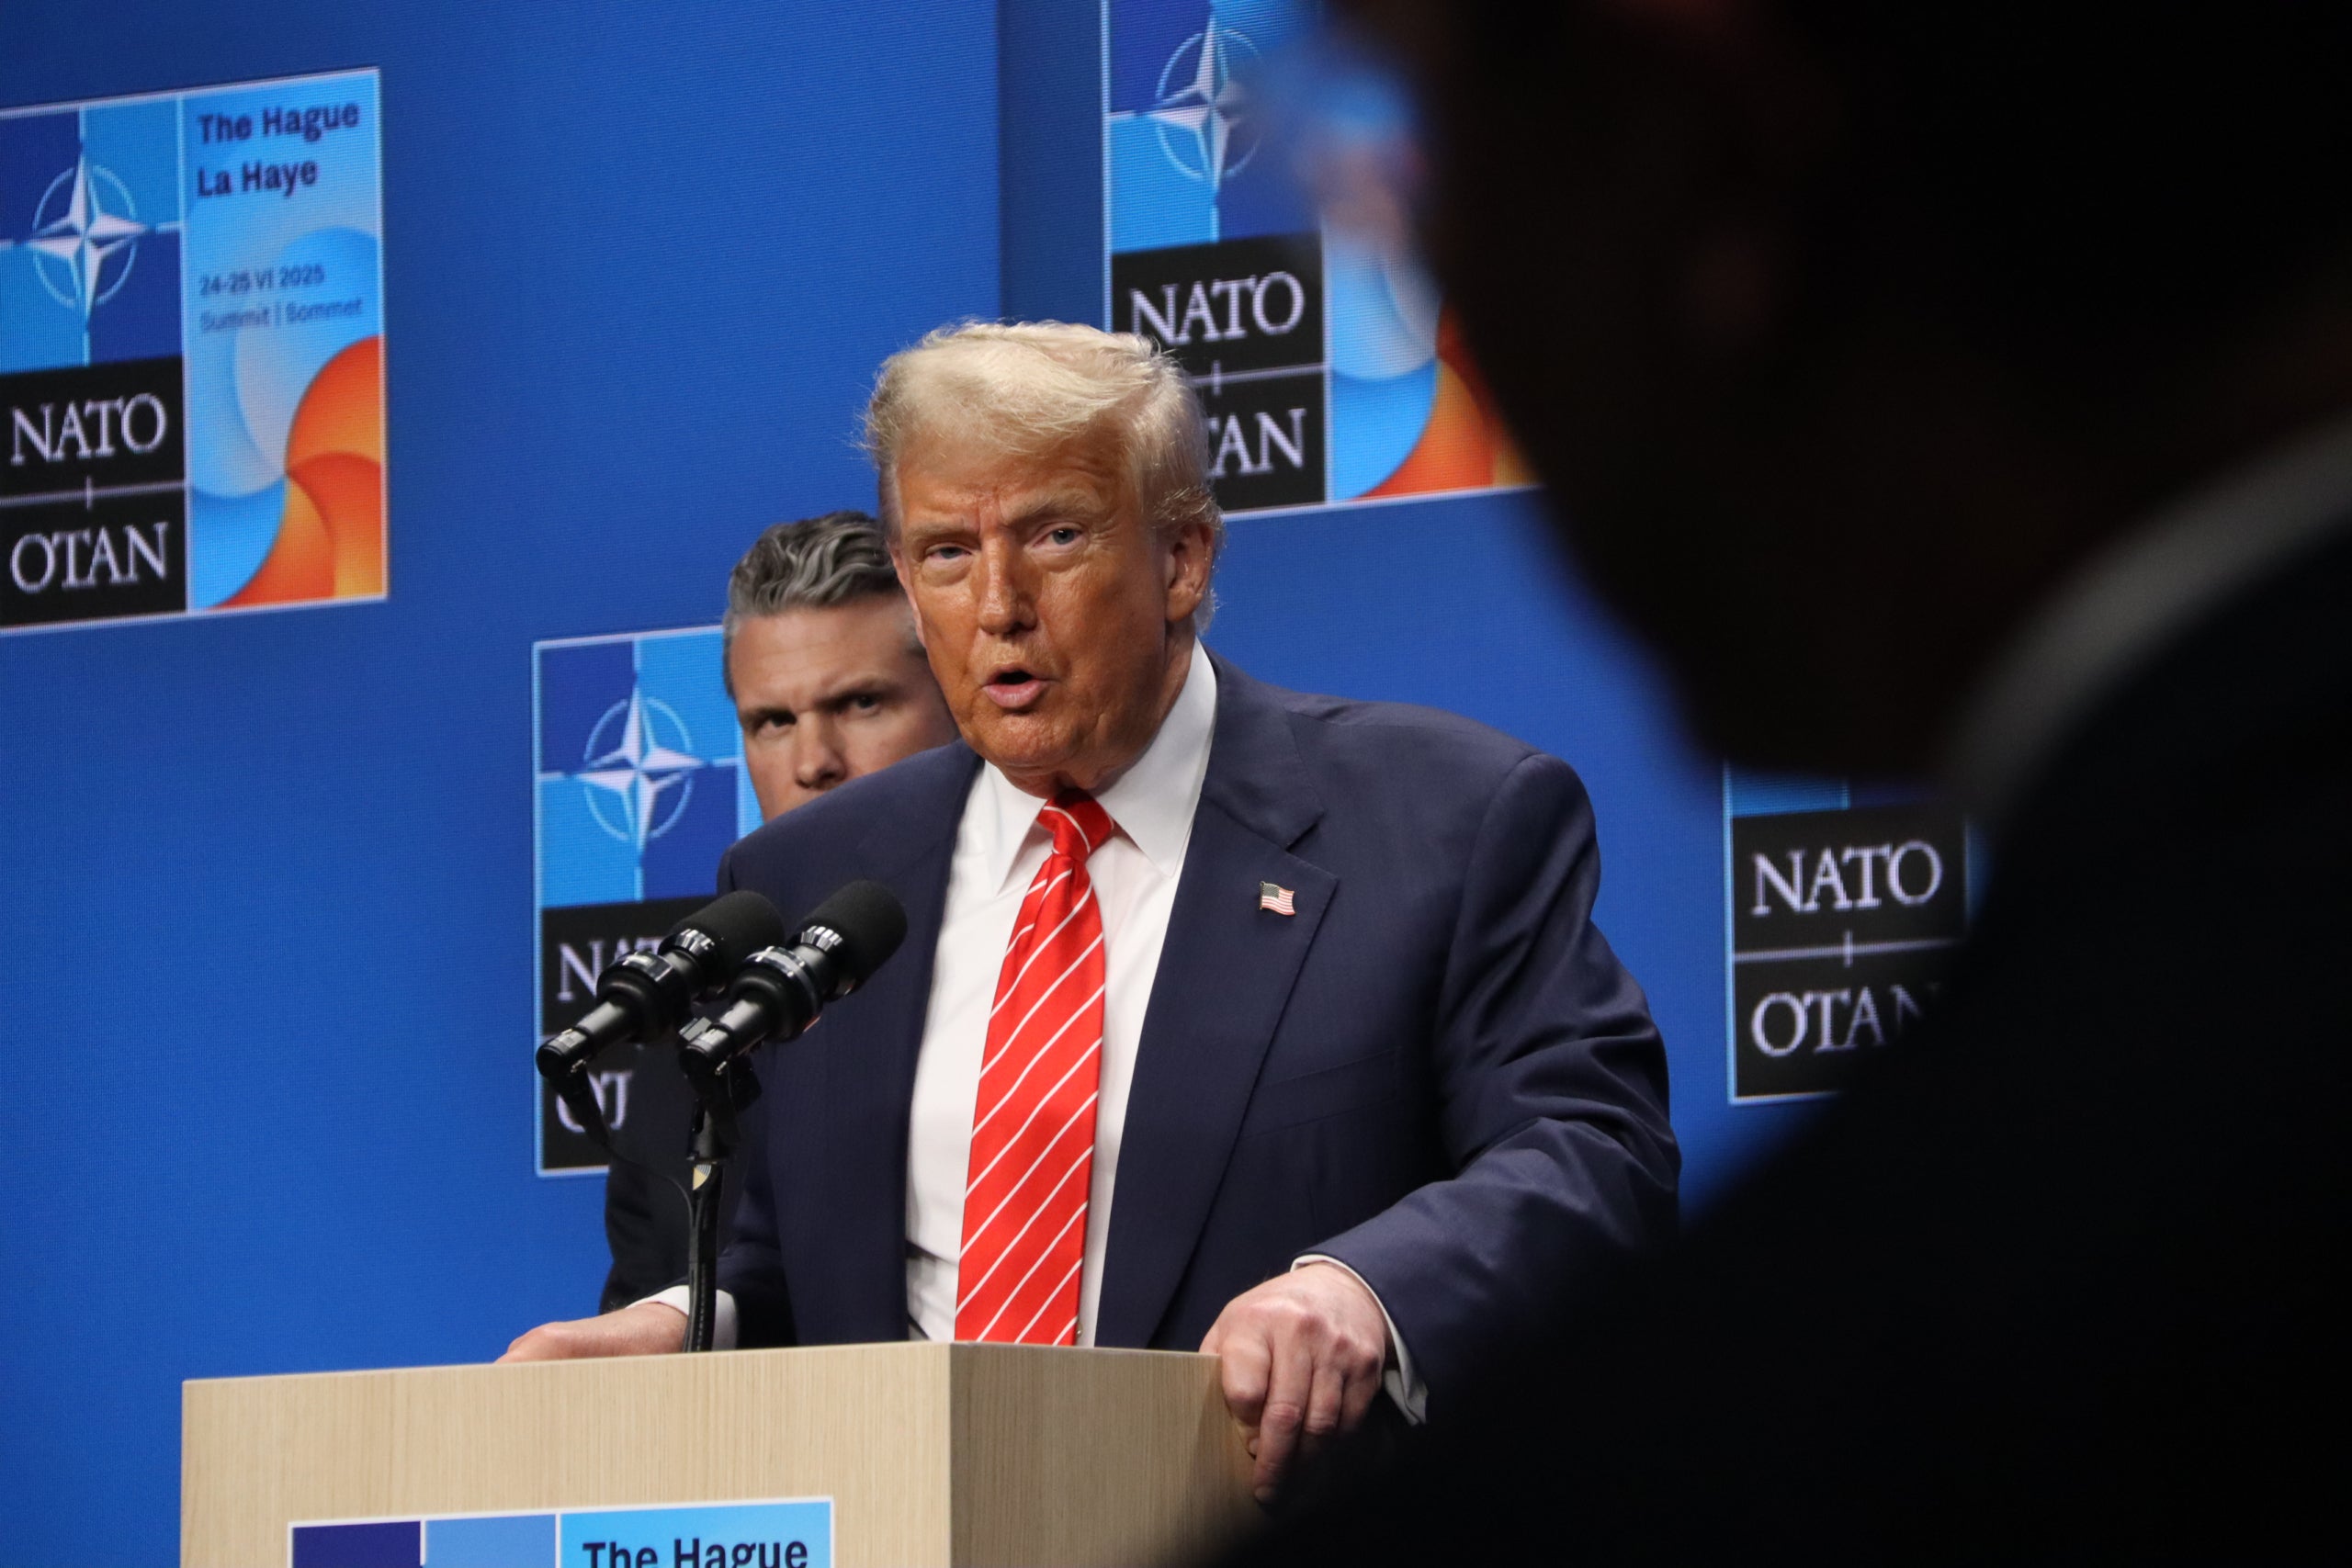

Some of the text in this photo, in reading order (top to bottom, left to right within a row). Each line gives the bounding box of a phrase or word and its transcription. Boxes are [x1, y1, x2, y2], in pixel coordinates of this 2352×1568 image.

[198, 103, 360, 144] The Hague
[197, 159, 319, 197] La Haye
[199, 264, 325, 297] 24-25 VI 2025
[198, 305, 270, 333] Summit
[286, 297, 362, 324] Sommet
[1128, 271, 1306, 345] NATO
[10, 392, 168, 466] NATO
[10, 521, 169, 594] OTAN
[1750, 840, 1943, 917] NATO
[582, 1537, 808, 1568] The Hague
